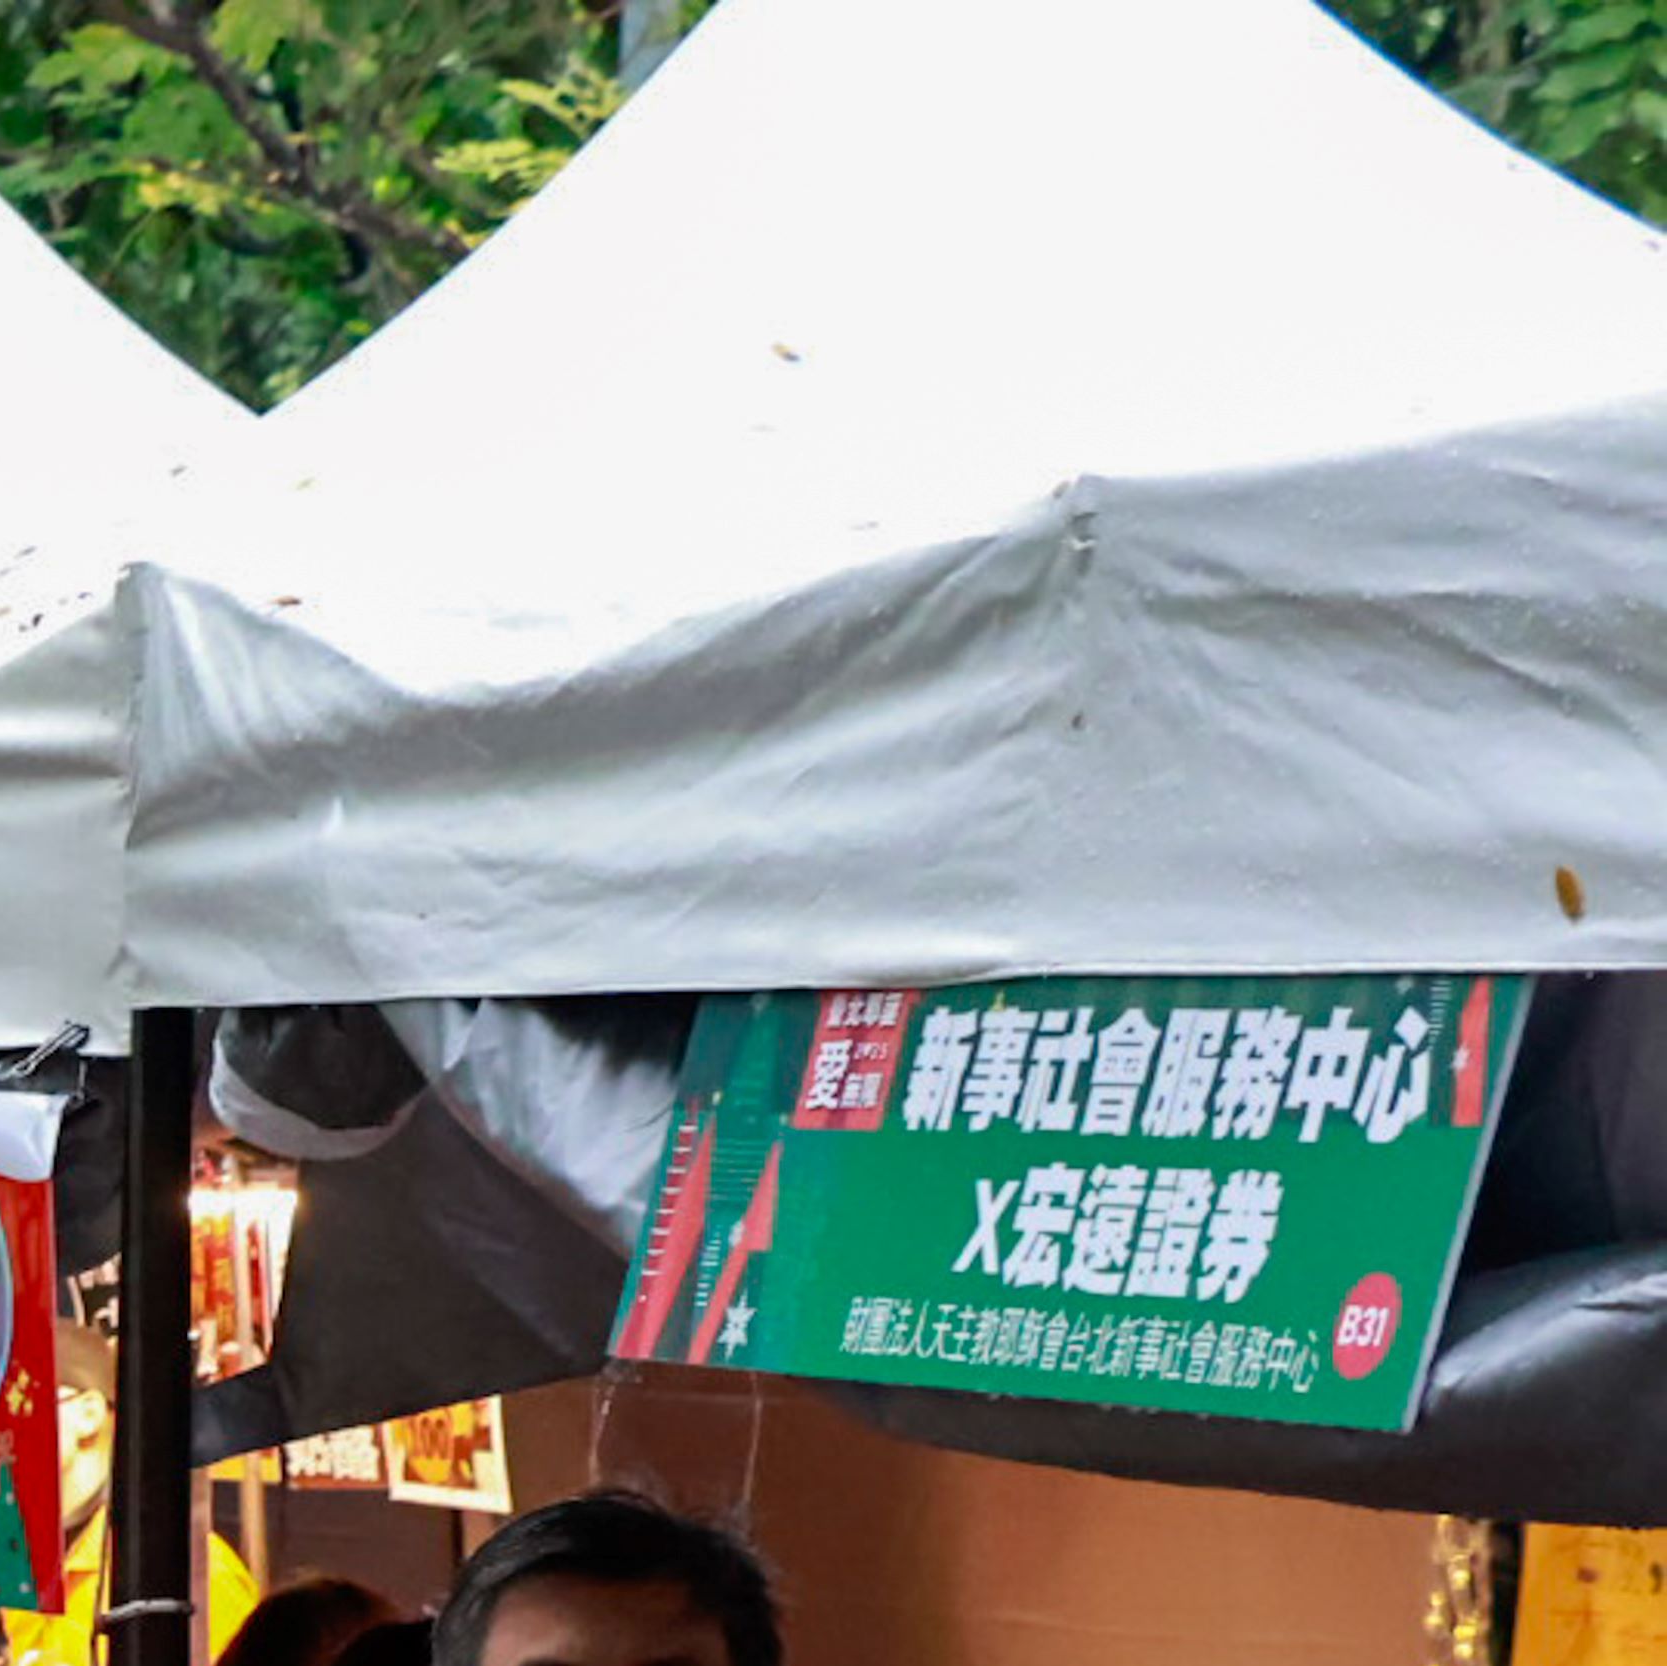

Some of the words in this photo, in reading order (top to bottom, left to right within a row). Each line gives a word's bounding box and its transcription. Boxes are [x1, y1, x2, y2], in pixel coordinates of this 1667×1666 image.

[903, 1005, 1430, 1146] 新事社會服務中心
[952, 1161, 1284, 1303] X宏遠證券
[1337, 1305, 1391, 1348] B31
